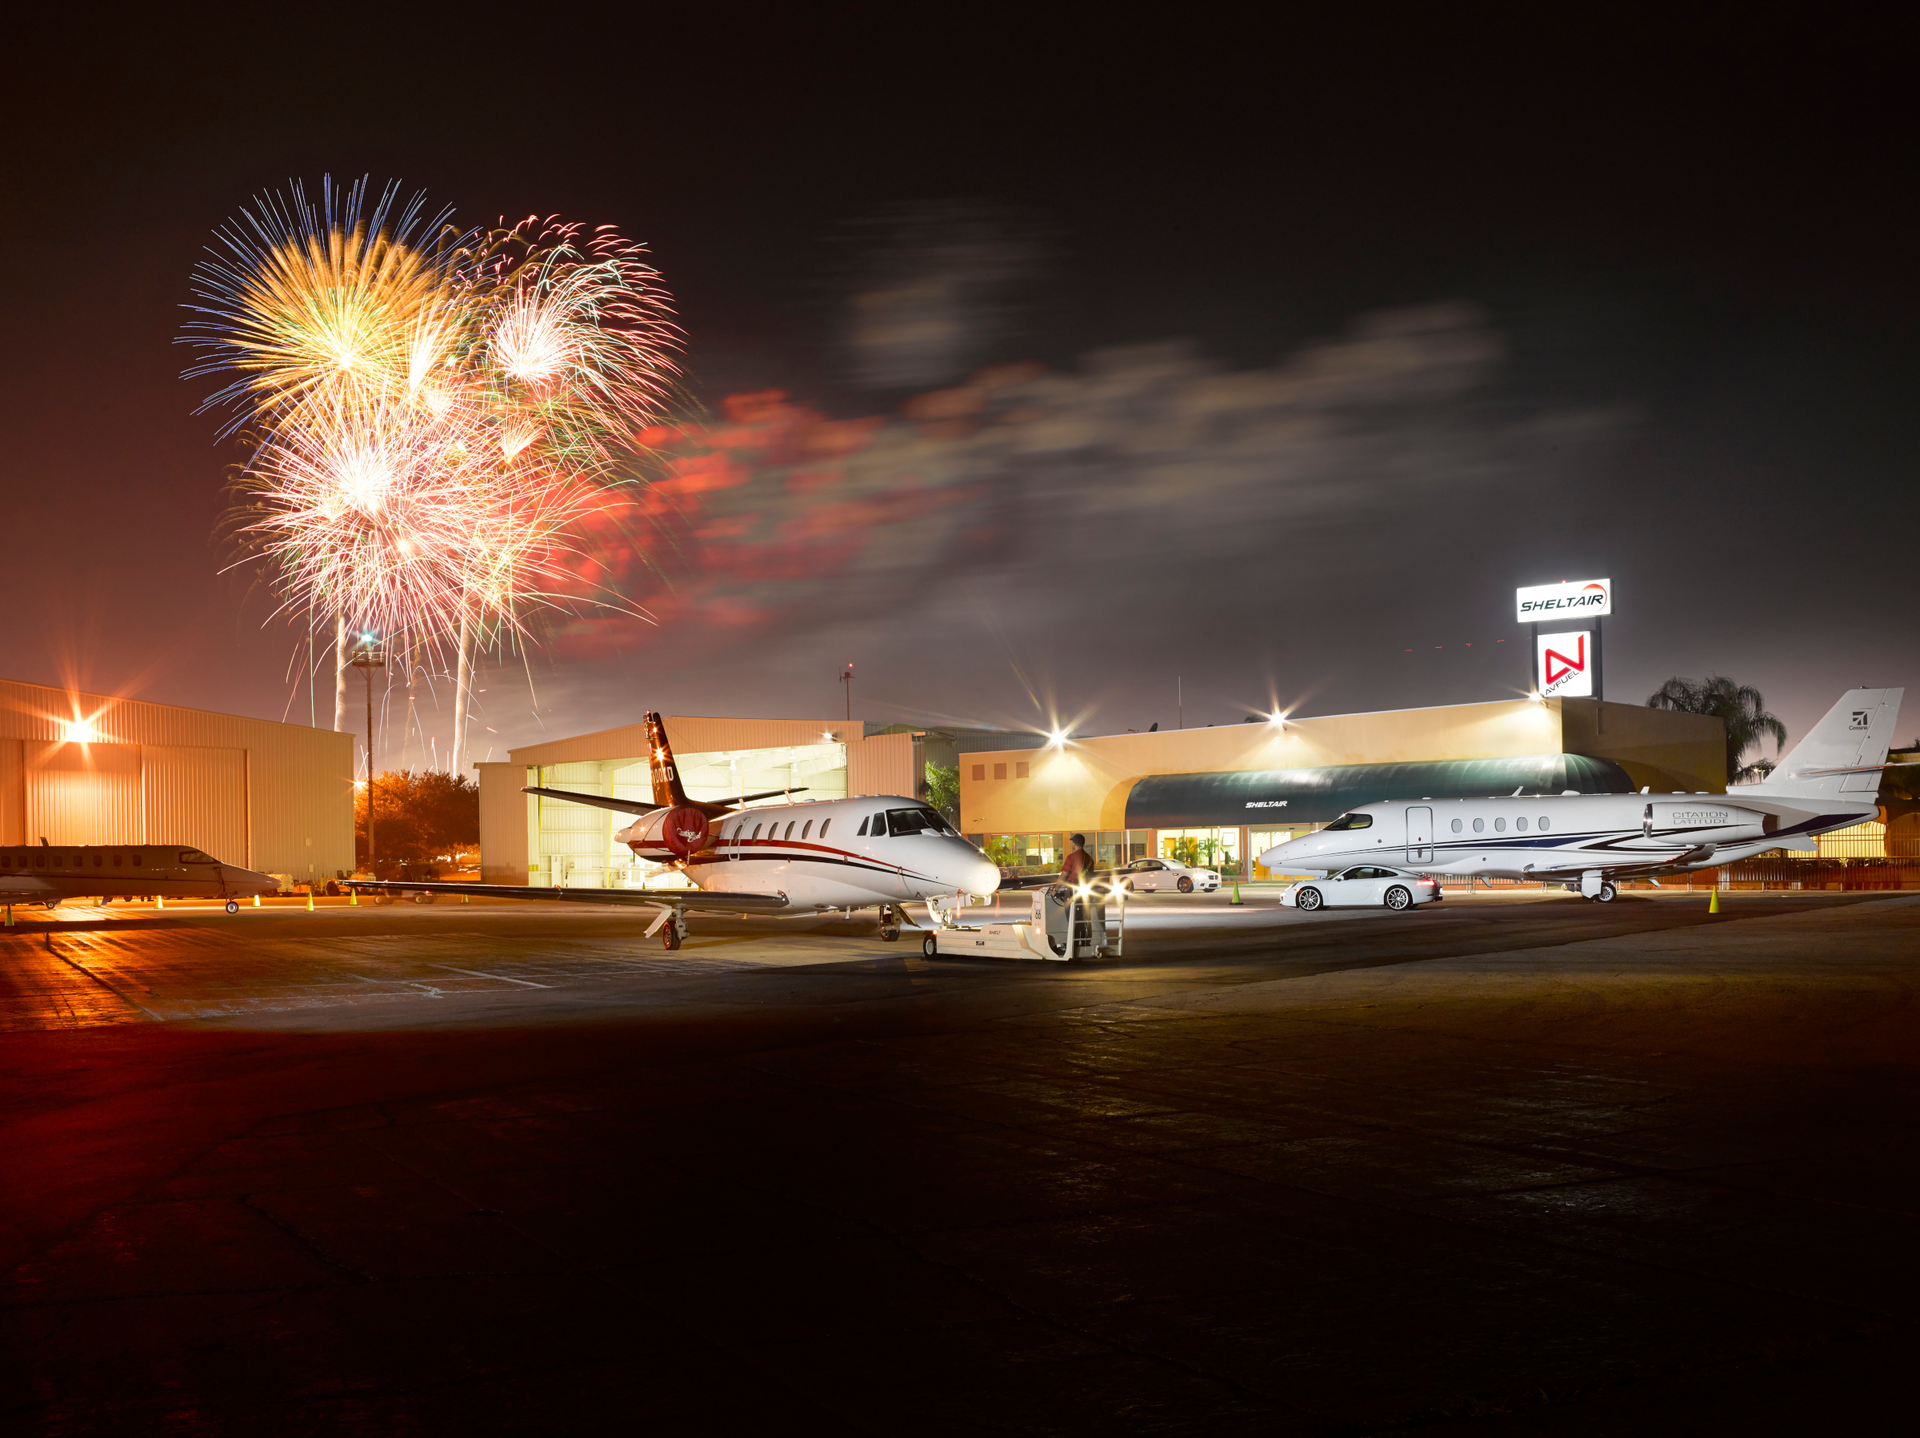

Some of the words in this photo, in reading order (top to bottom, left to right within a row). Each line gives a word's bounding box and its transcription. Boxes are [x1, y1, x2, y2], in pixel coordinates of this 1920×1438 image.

[1520, 595, 1604, 612] SHELTAIR
[1545, 670, 1580, 696] AVFUEL
[1245, 800, 1288, 809] SHELTAIR
